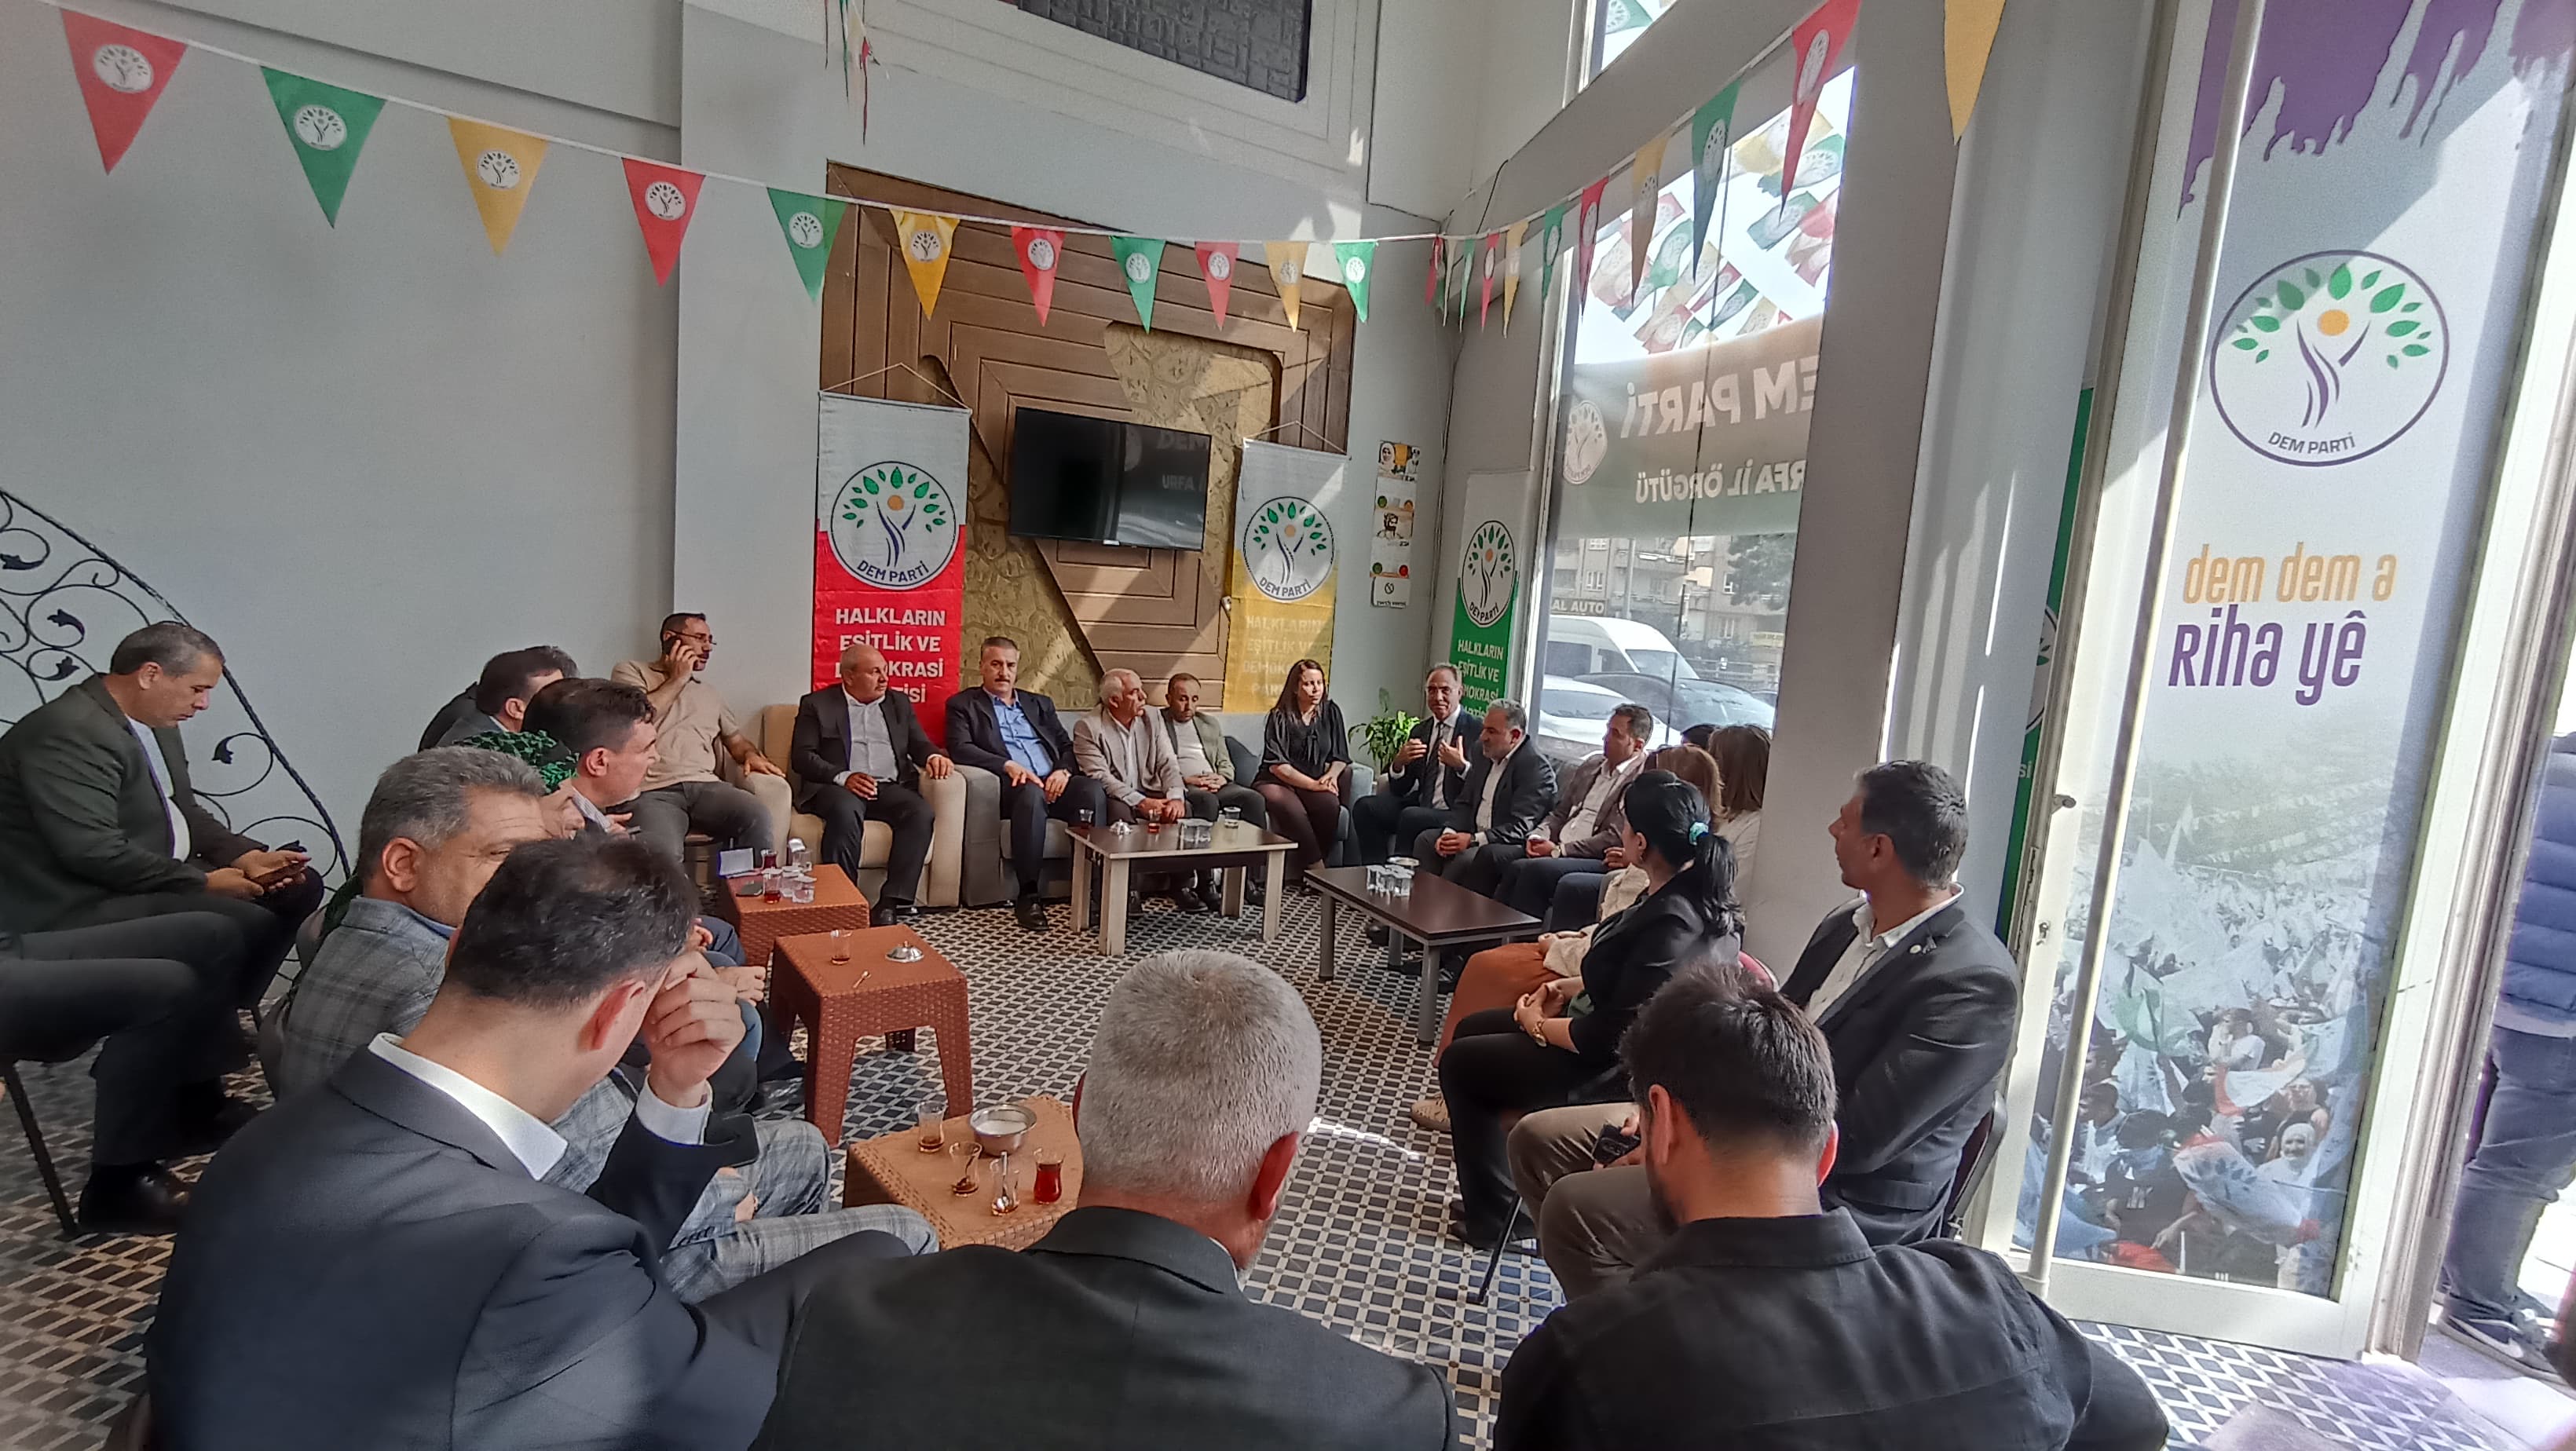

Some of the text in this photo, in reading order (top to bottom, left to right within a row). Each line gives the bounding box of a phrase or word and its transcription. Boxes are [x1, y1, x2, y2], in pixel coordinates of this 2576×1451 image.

[2268, 432, 2356, 454] DEM PARTİ
[857, 560, 929, 582] DEM PARTİ
[2183, 542, 2397, 604] dem dem a
[1259, 576, 1312, 597] DEM PARTİ
[836, 607, 946, 626] HALKLARIN
[1571, 601, 1605, 614] AUTO
[917, 635, 942, 652] VE
[1458, 639, 1504, 660] HALKLARIN
[2168, 604, 2368, 706] Riha yê
[1487, 667, 1500, 683] VE
